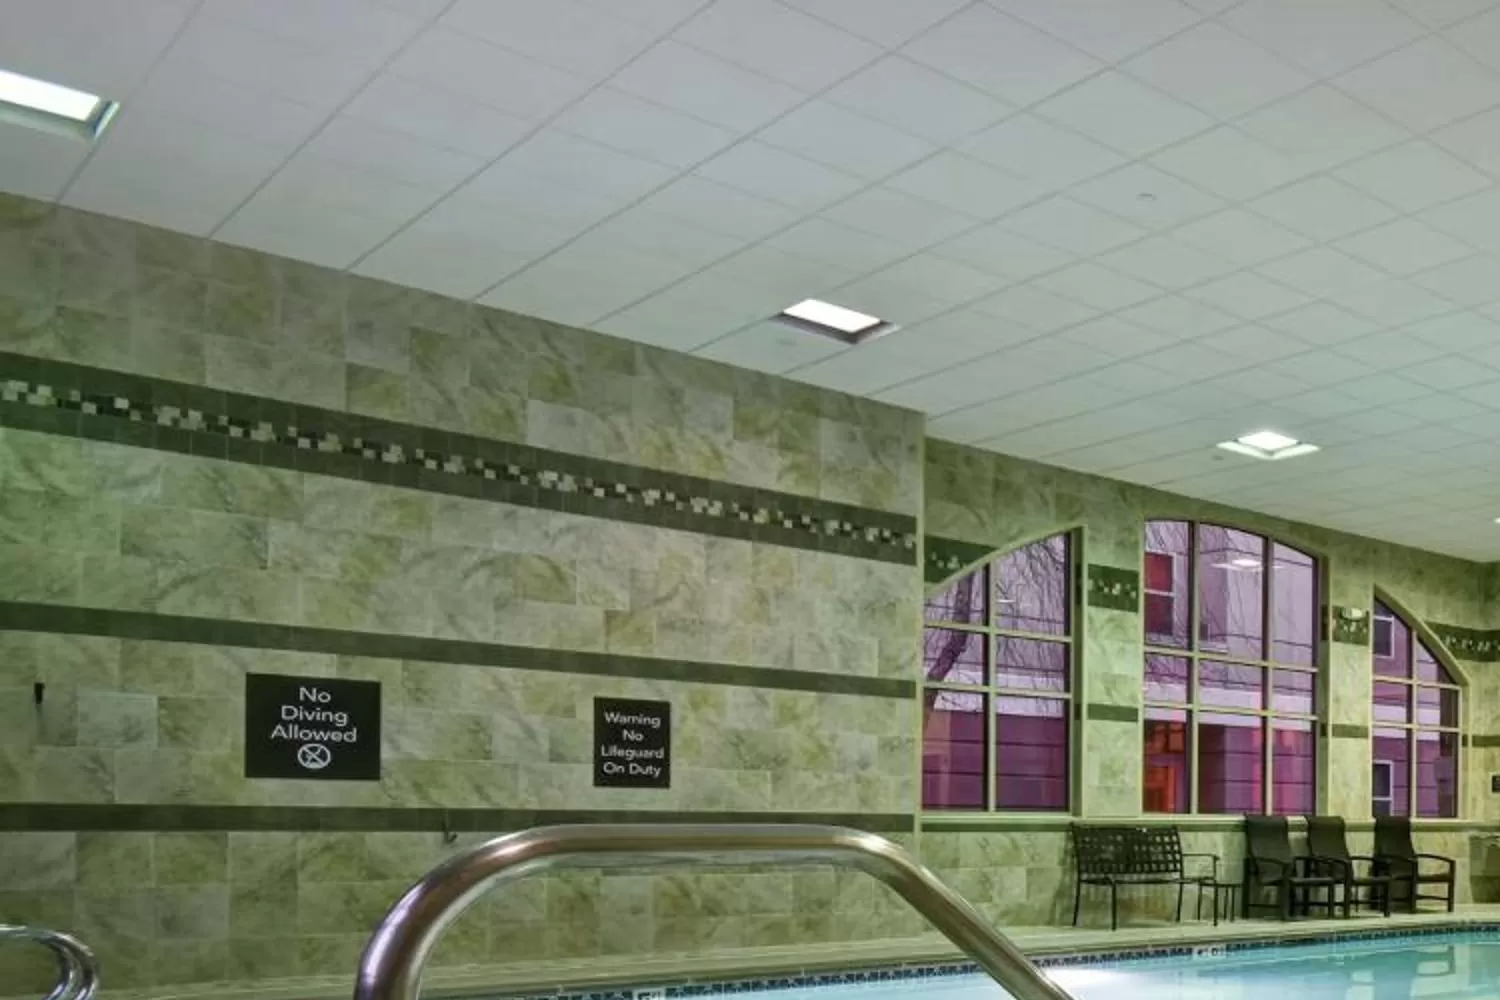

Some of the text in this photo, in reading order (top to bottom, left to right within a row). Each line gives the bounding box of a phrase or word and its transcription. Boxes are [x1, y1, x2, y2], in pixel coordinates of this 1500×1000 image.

[299, 686, 332, 703] No
[281, 705, 348, 727] Diving
[603, 711, 662, 729] Warning
[271, 723, 358, 743] Allowed
[622, 728, 644, 742] No
[601, 743, 665, 761] Lifeguard
[603, 761, 662, 779] On Duty
